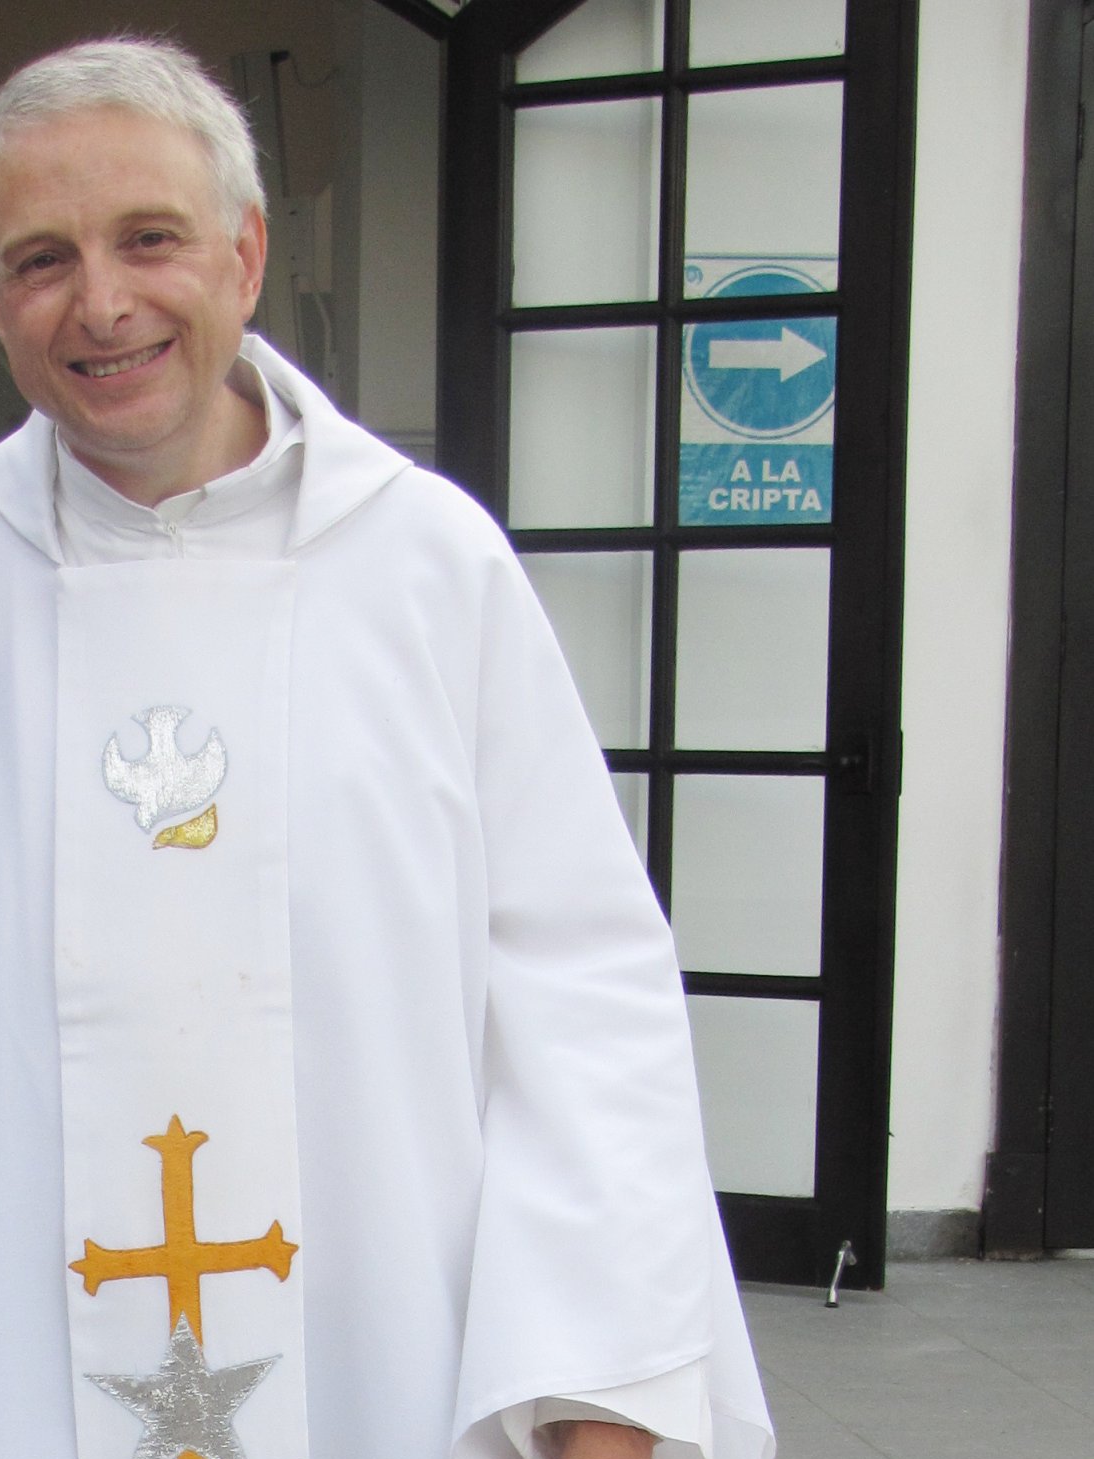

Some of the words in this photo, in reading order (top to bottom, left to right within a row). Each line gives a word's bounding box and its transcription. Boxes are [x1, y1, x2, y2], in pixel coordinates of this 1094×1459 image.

[730, 460, 752, 482] A
[762, 460, 801, 482] LA
[709, 488, 823, 511] CRIPTA
